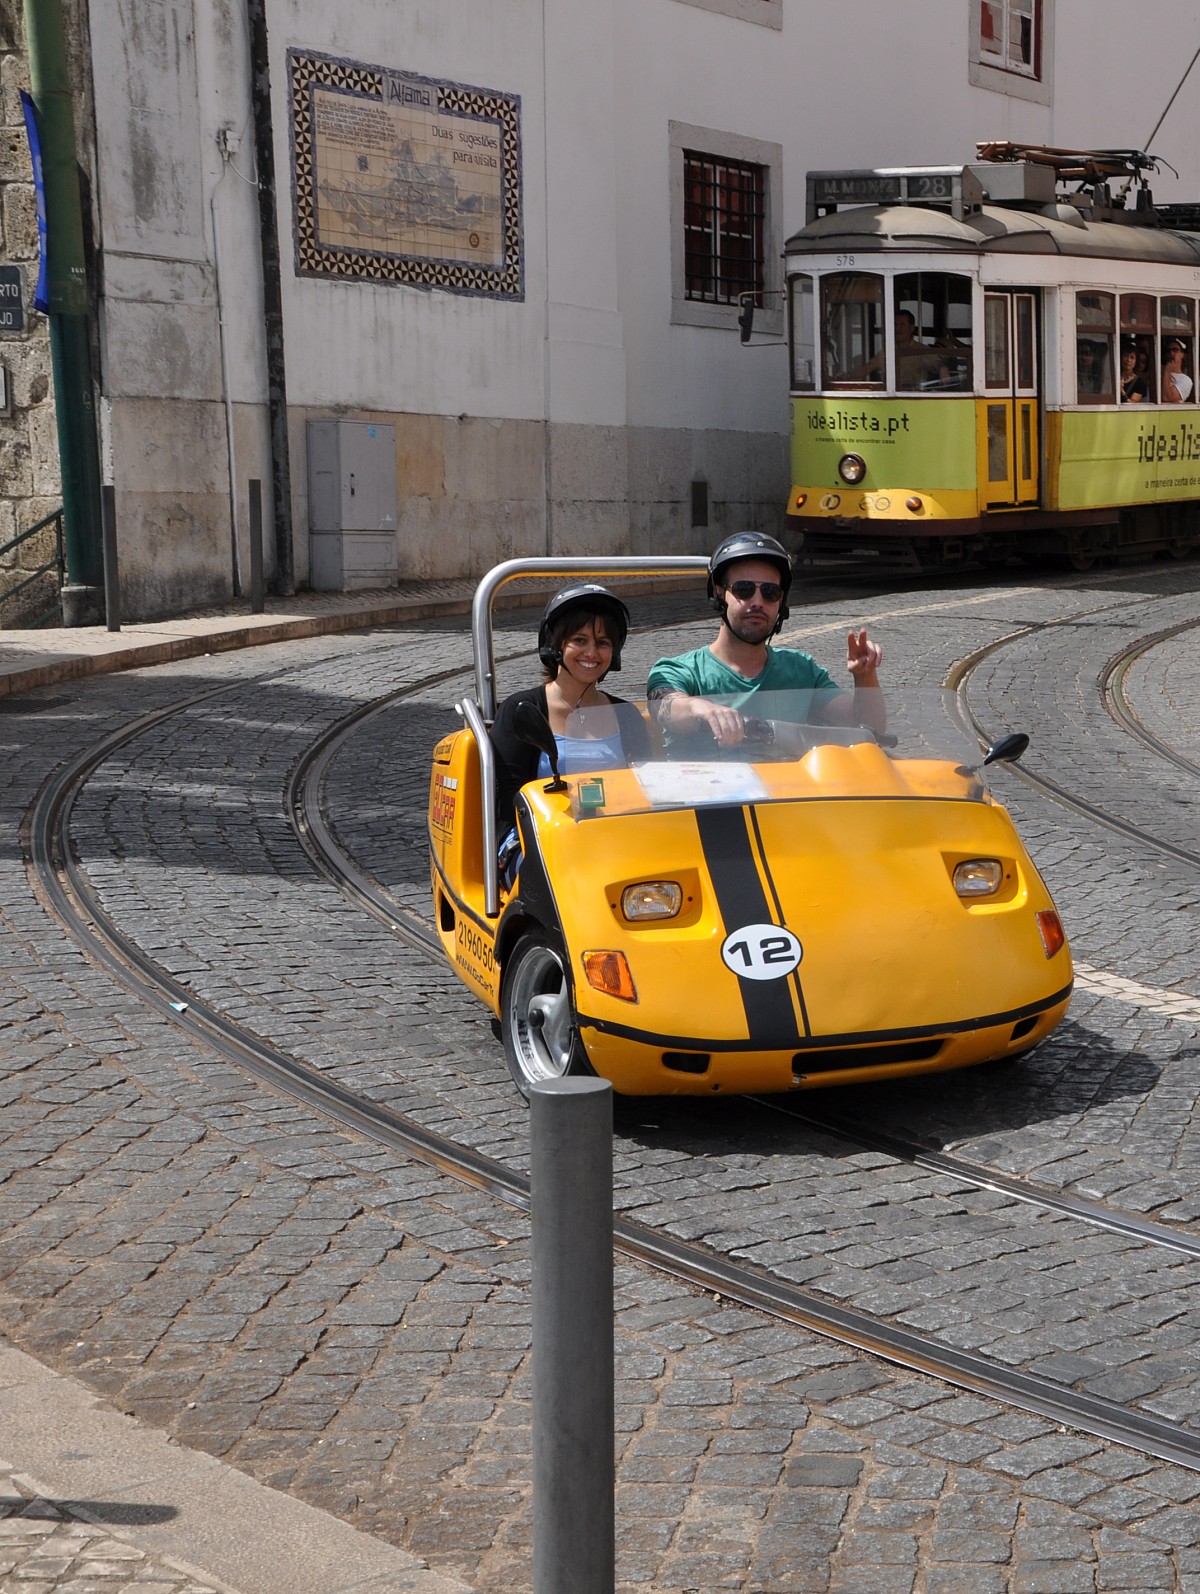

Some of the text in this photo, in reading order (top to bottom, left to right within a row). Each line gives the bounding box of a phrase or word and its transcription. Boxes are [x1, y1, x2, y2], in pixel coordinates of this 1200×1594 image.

[390, 79, 430, 106] Alfama
[431, 125, 454, 140] Duas
[453, 151, 497, 168] para visita
[918, 176, 946, 197] 28
[836, 255, 855, 267] 578
[807, 411, 910, 437] idealista.pt
[1150, 477, 1174, 488] maneira
[1174, 477, 1189, 487] certa
[1189, 476, 1196, 485] de
[728, 936, 796, 967] 12
